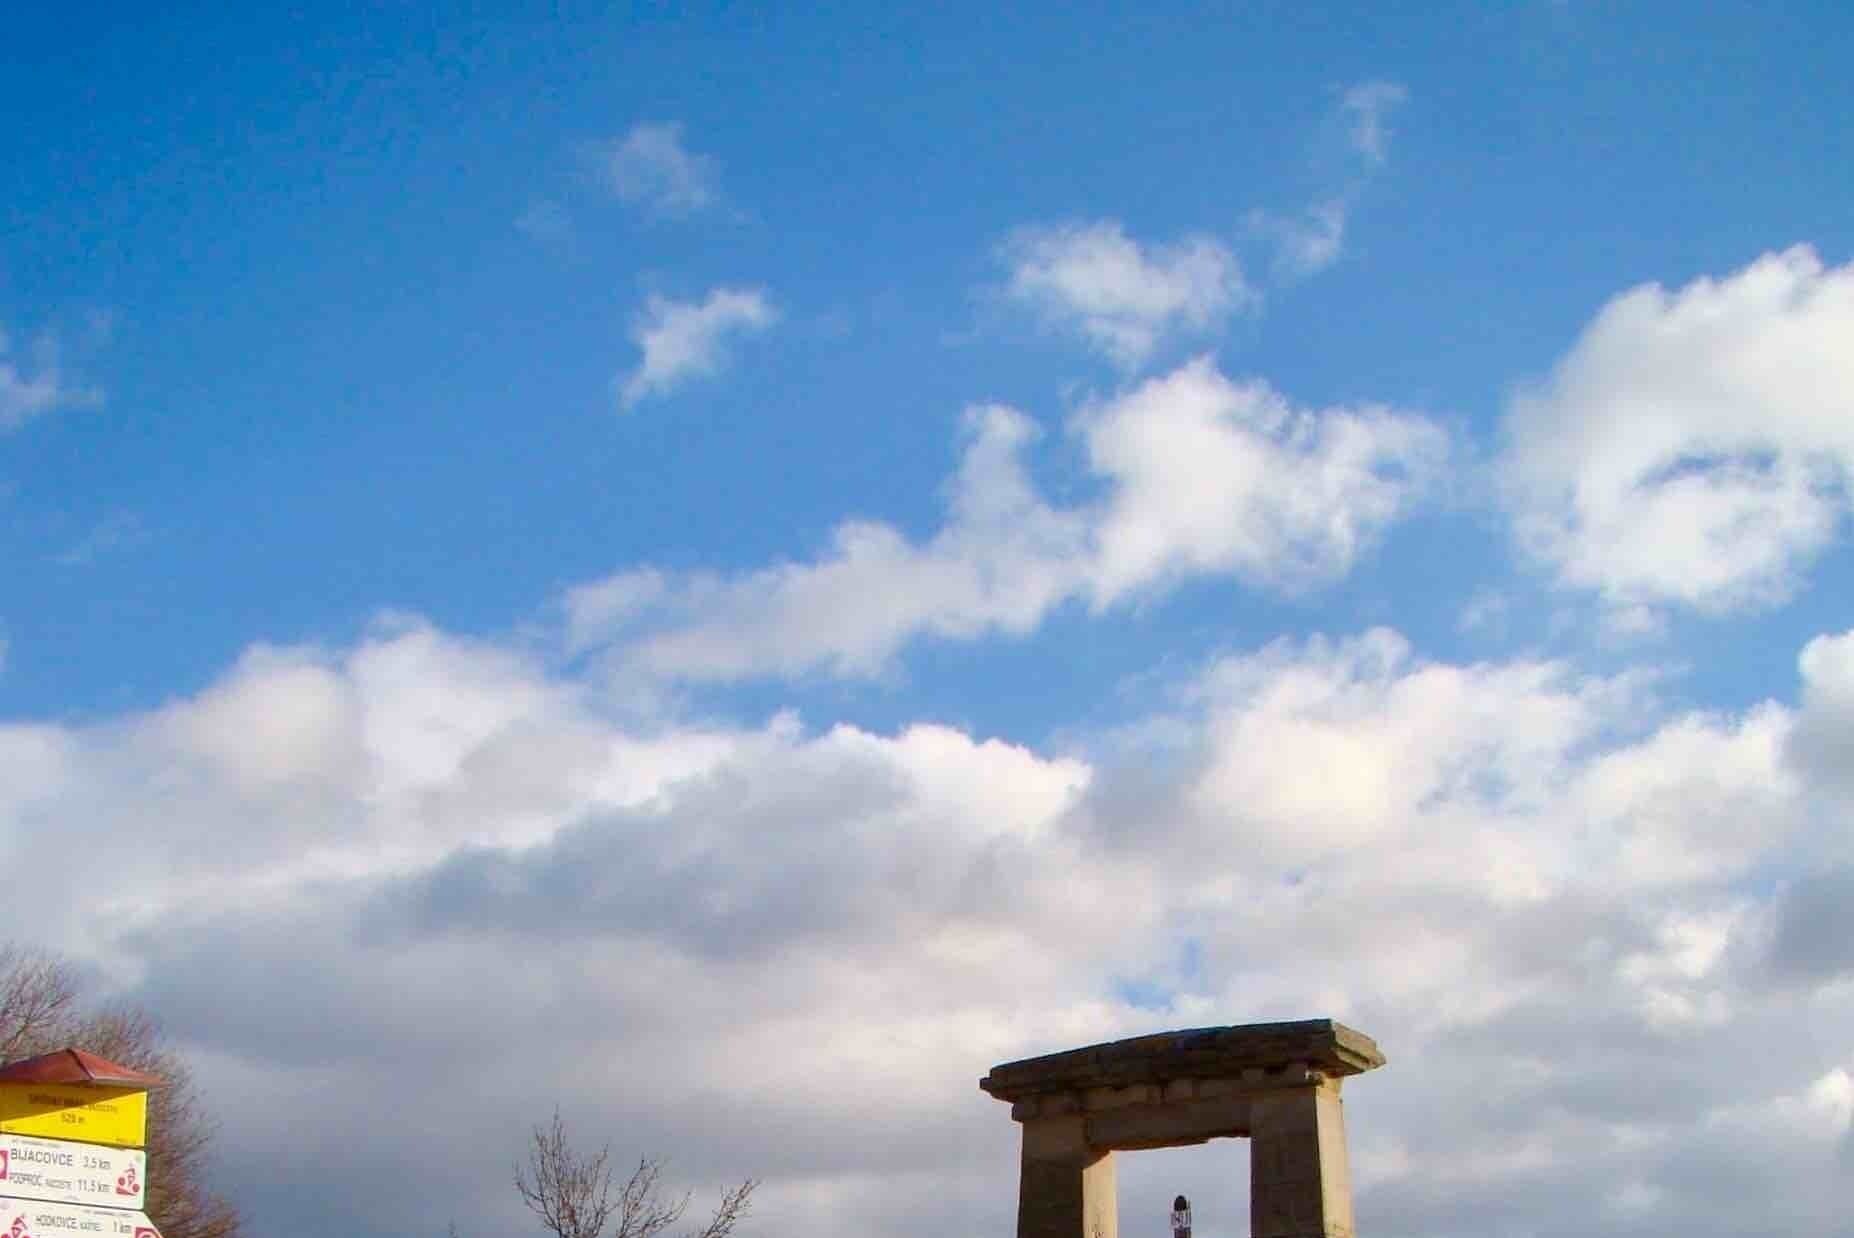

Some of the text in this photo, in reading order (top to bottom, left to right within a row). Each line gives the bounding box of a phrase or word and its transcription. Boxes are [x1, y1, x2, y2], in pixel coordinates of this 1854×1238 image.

[11, 1148, 73, 1166] BIJACOVCE
[98, 1159, 112, 1169] km
[98, 1182, 111, 1193] km
[119, 1222, 131, 1233] km
